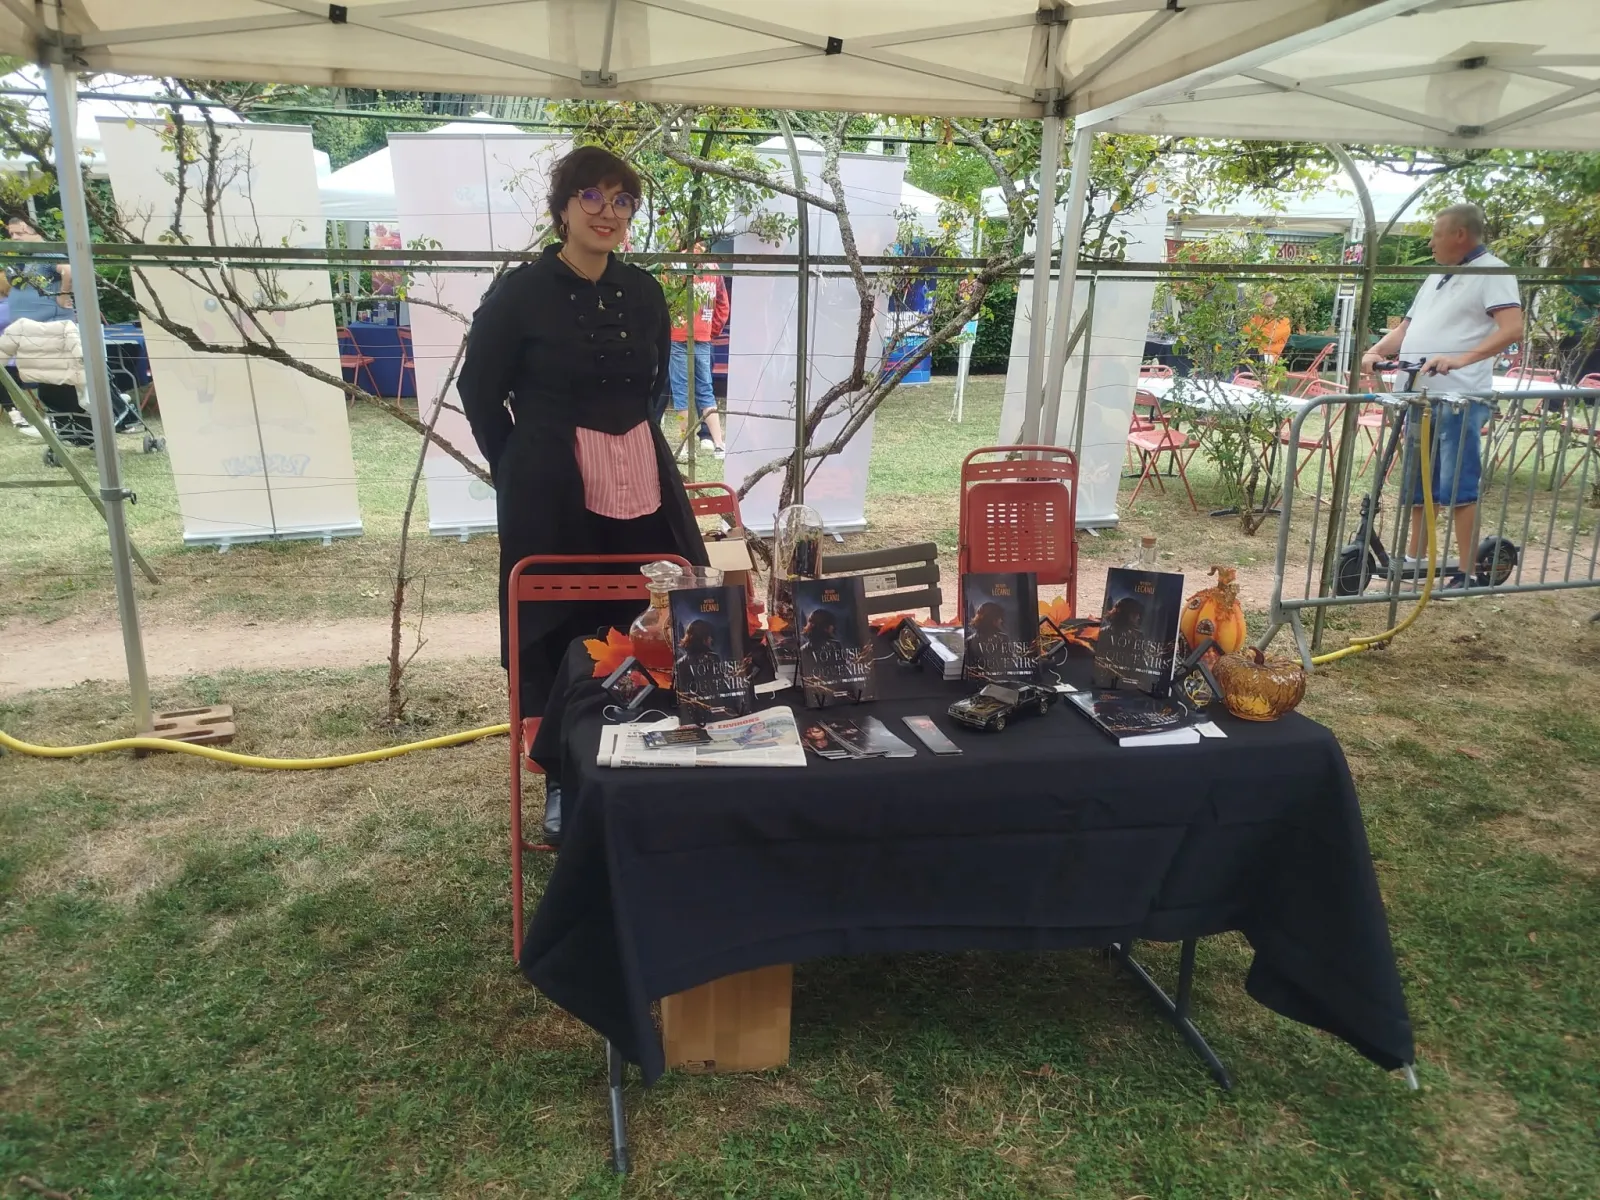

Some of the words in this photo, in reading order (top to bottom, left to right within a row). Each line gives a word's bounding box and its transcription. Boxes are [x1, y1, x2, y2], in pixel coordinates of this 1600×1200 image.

[978, 641, 1030, 653] VOEUSE
[1110, 635, 1164, 653] VOEUSE
[812, 647, 861, 663] VOEUSE
[689, 660, 742, 676] VOEUSE
[718, 716, 760, 729] ENVIRONS
